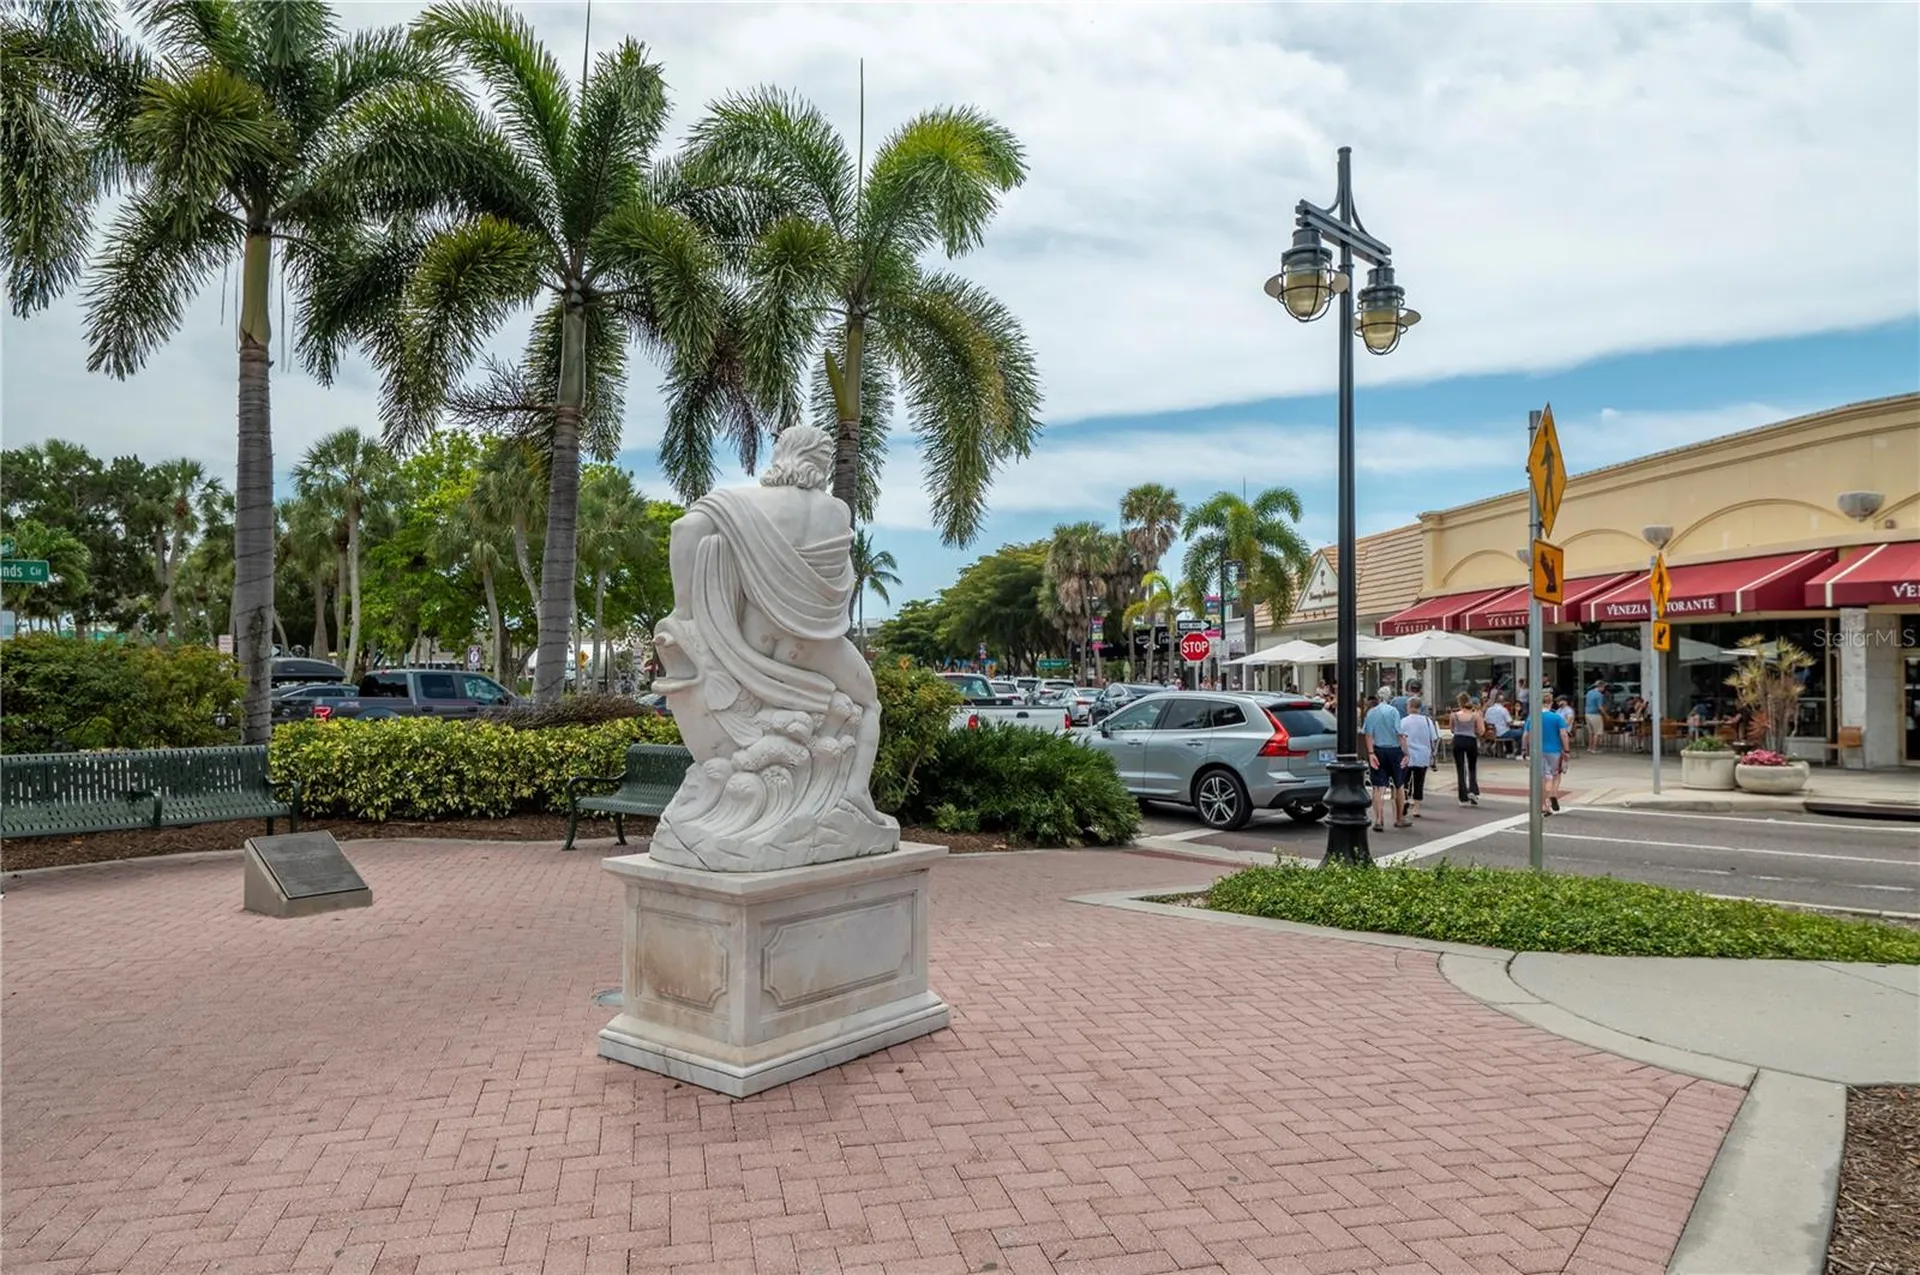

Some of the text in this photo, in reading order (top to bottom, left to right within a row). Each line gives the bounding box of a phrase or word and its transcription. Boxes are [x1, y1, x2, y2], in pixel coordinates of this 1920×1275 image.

[0, 564, 23, 578] nds
[1892, 582, 1920, 598] VE
[1607, 598, 1716, 616] VENEZIA TORANTE
[1487, 614, 1528, 627] VENEZI
[1182, 641, 1208, 654] STOP
